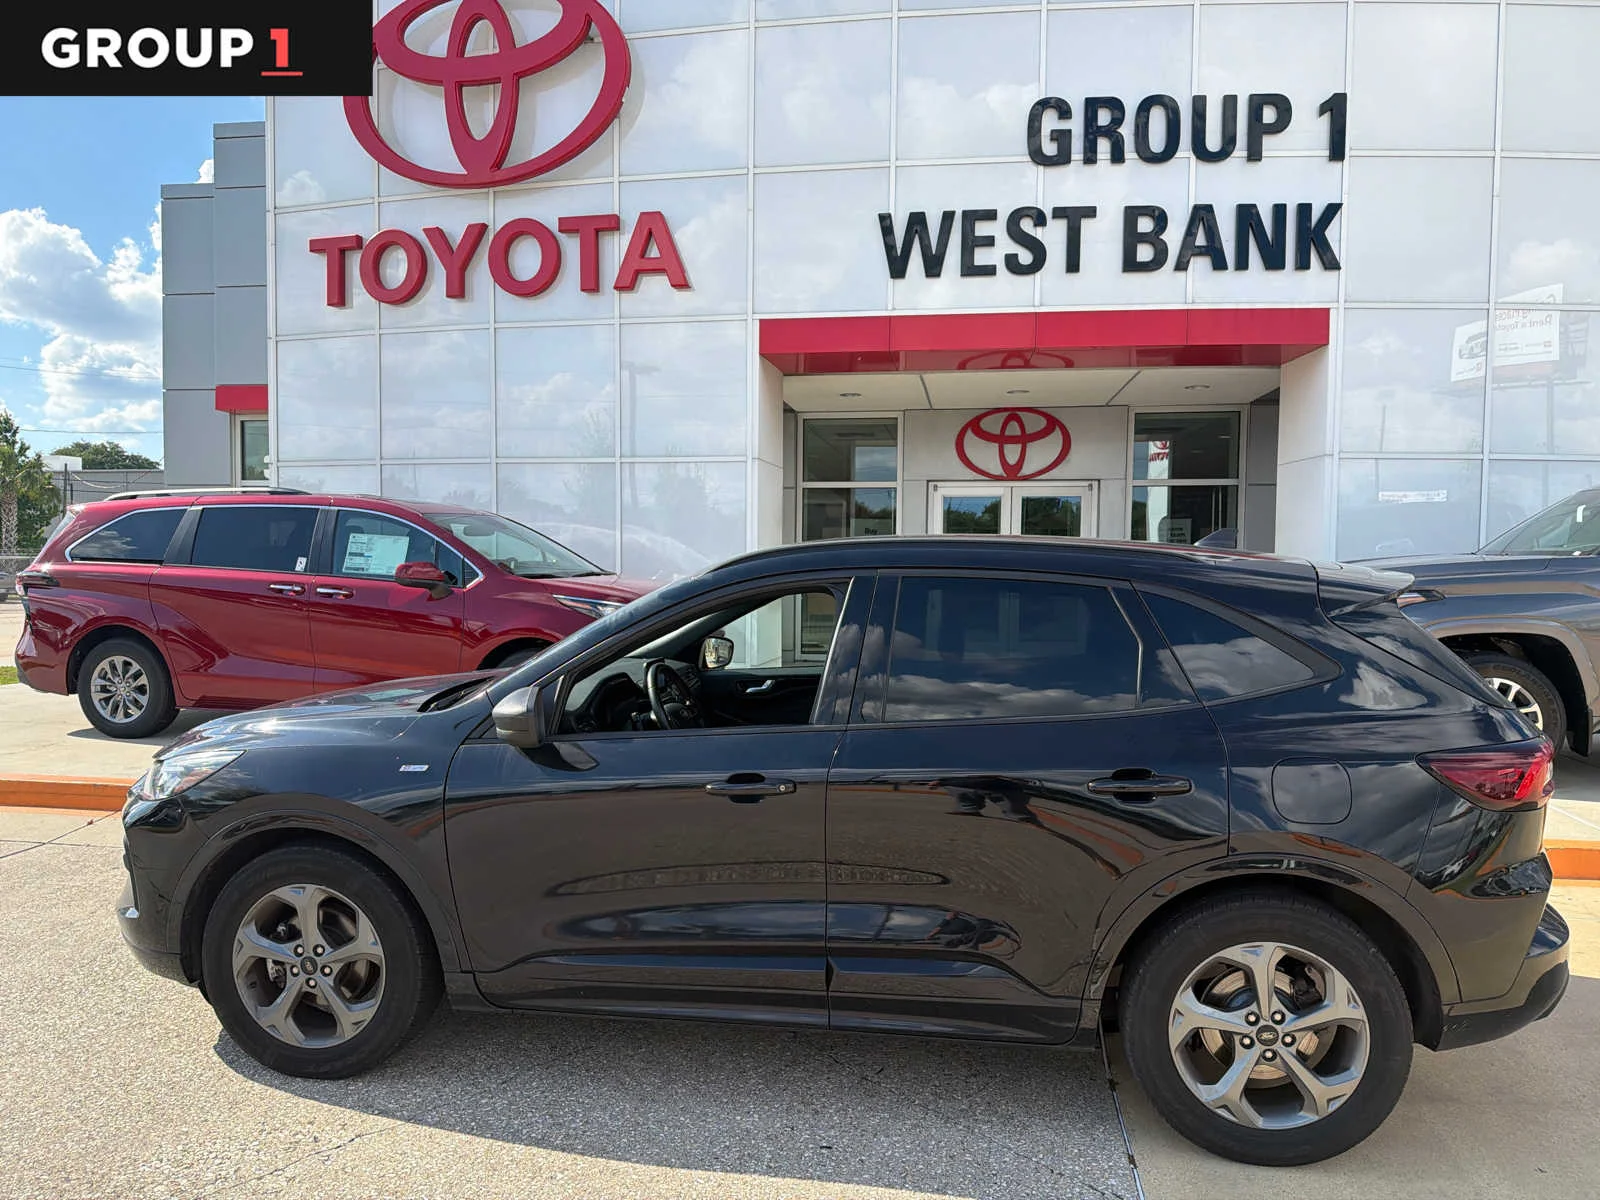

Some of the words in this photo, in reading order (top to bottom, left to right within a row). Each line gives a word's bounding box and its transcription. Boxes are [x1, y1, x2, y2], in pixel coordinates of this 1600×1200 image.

[1026, 94, 1293, 166] GROUP
[1318, 92, 1348, 162] 1
[308, 210, 692, 308] TOYOTA
[878, 206, 1097, 279] WEST
[1121, 202, 1344, 274] BANK
